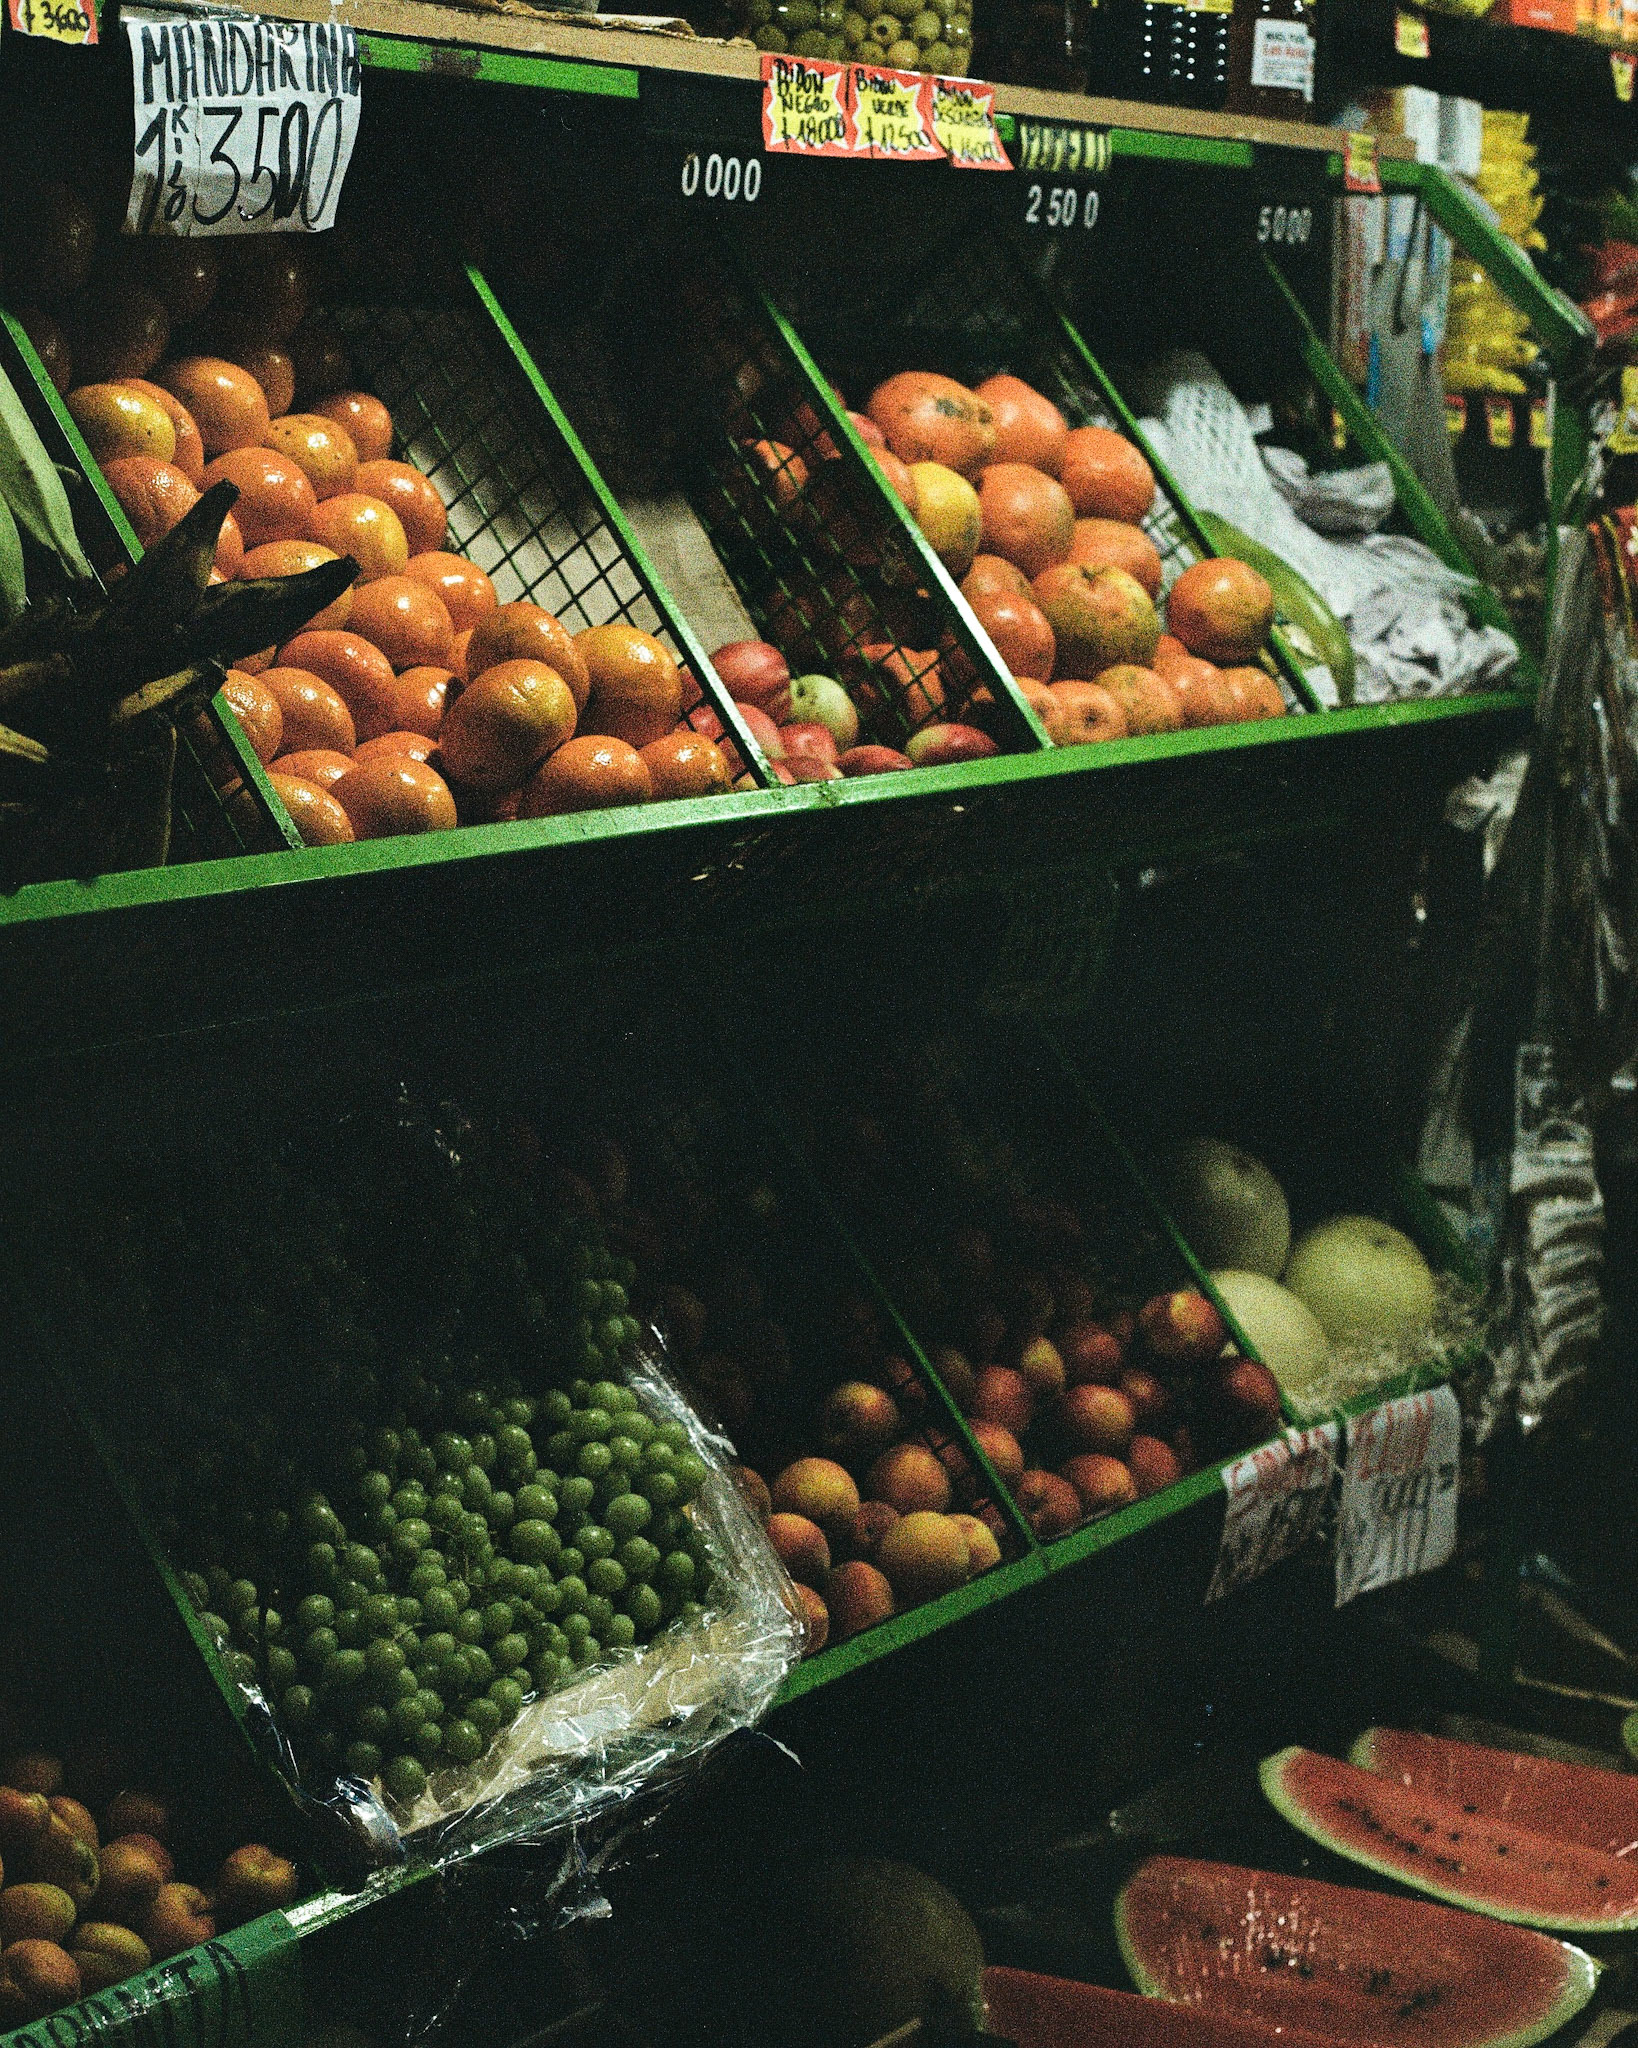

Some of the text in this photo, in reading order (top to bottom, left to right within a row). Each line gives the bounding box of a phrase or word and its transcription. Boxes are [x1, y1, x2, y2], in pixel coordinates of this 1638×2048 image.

[141, 21, 361, 105] MANDARINA
[135, 107, 168, 234] 1
[193, 98, 344, 230] 3500
[681, 152, 762, 202] 0000
[1025, 184, 1100, 229] 2500
